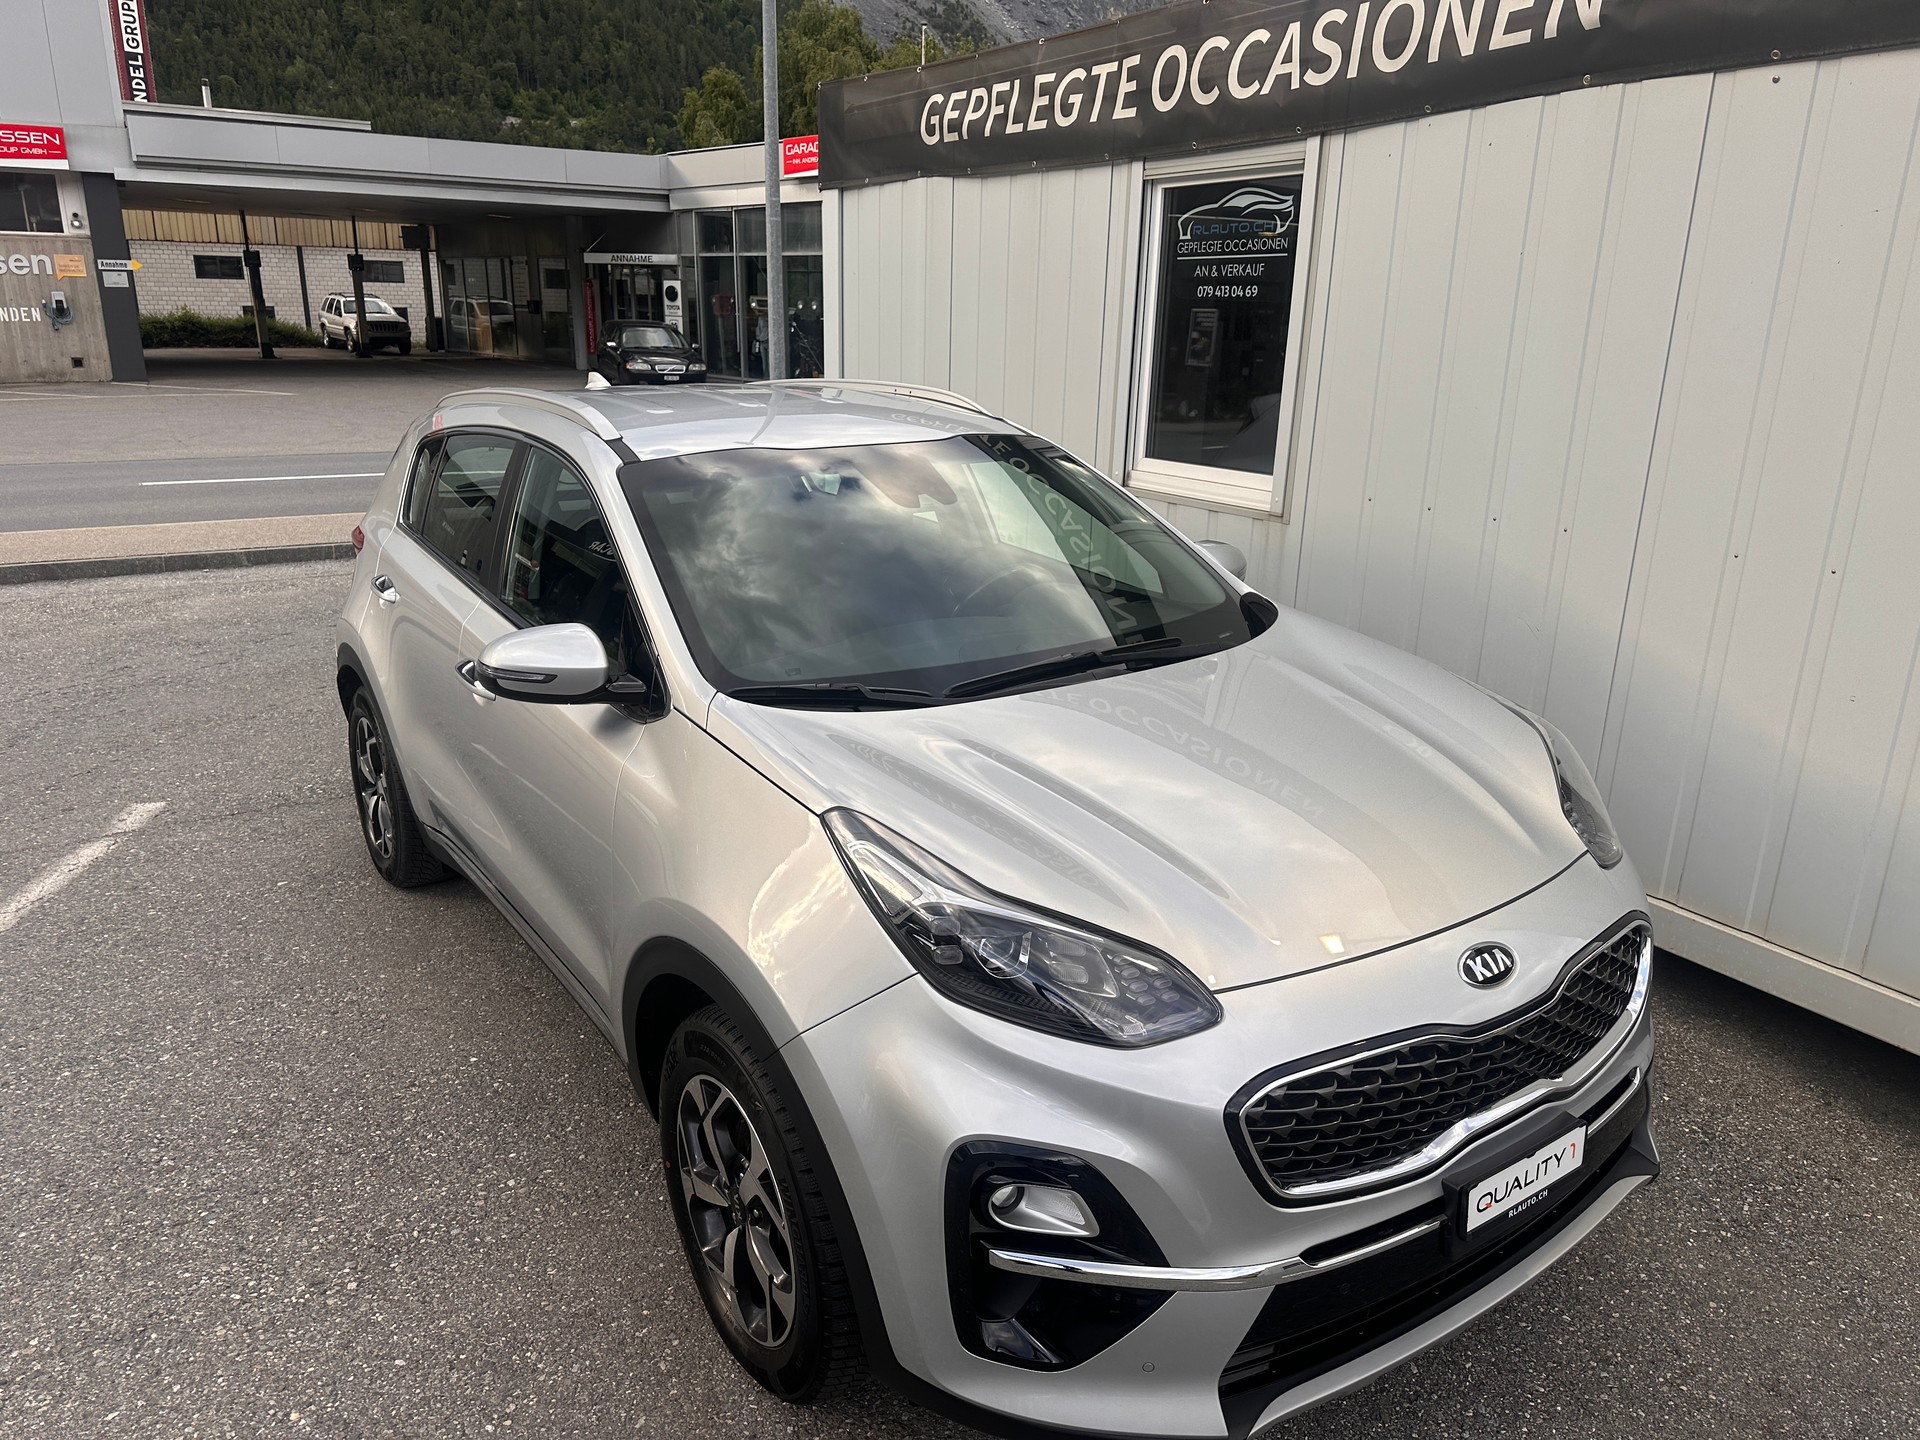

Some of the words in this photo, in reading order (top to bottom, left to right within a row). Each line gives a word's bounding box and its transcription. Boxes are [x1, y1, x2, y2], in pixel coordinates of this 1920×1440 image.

[121, 0, 140, 50] GRUP
[920, 54, 1141, 146] GEPFLEGTE
[1192, 220, 1275, 235] RLAUTO.CH
[1177, 240, 1223, 254] GEPFLEGTE
[1223, 237, 1289, 252] OCCASIONEN
[100, 260, 128, 269] Annahme
[610, 254, 653, 263] ANNAHME
[1194, 265, 1209, 277] AN
[1211, 265, 1218, 277] &
[1220, 263, 1265, 277] VERKAUF
[1197, 285, 1214, 298] 079
[1215, 285, 1229, 298] 413
[1231, 285, 1243, 298] 04
[1245, 285, 1258, 298] 69
[0, 306, 41, 322] NDEN
[1466, 948, 1513, 982] KIA
[1476, 1147, 1567, 1213] QUALITY
[1570, 1142, 1576, 1159] 1
[1508, 1189, 1548, 1218] RLAUTO.CH
